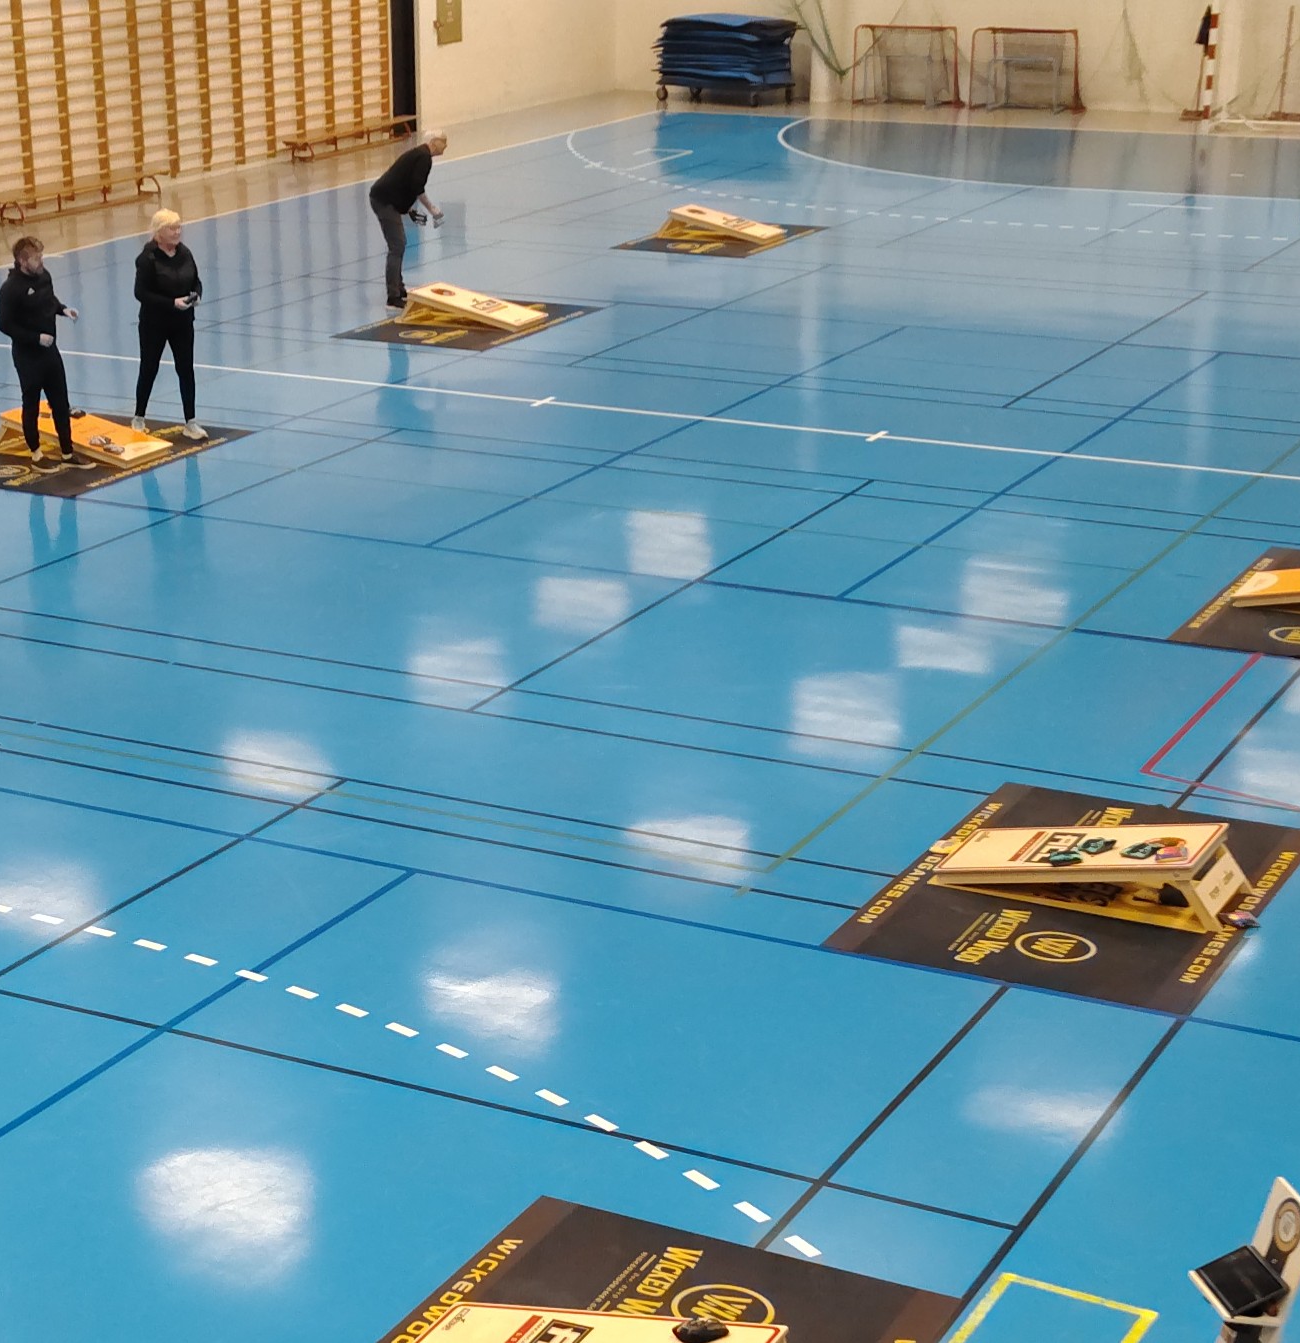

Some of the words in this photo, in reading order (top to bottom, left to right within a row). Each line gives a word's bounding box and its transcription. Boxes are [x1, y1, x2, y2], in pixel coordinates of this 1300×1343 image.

[856, 802, 1003, 924] WICKEDDGAMES.COM
[1178, 851, 1299, 984] WICKEDWOOAMES.COM
[636, 1247, 704, 1297] WICKED
